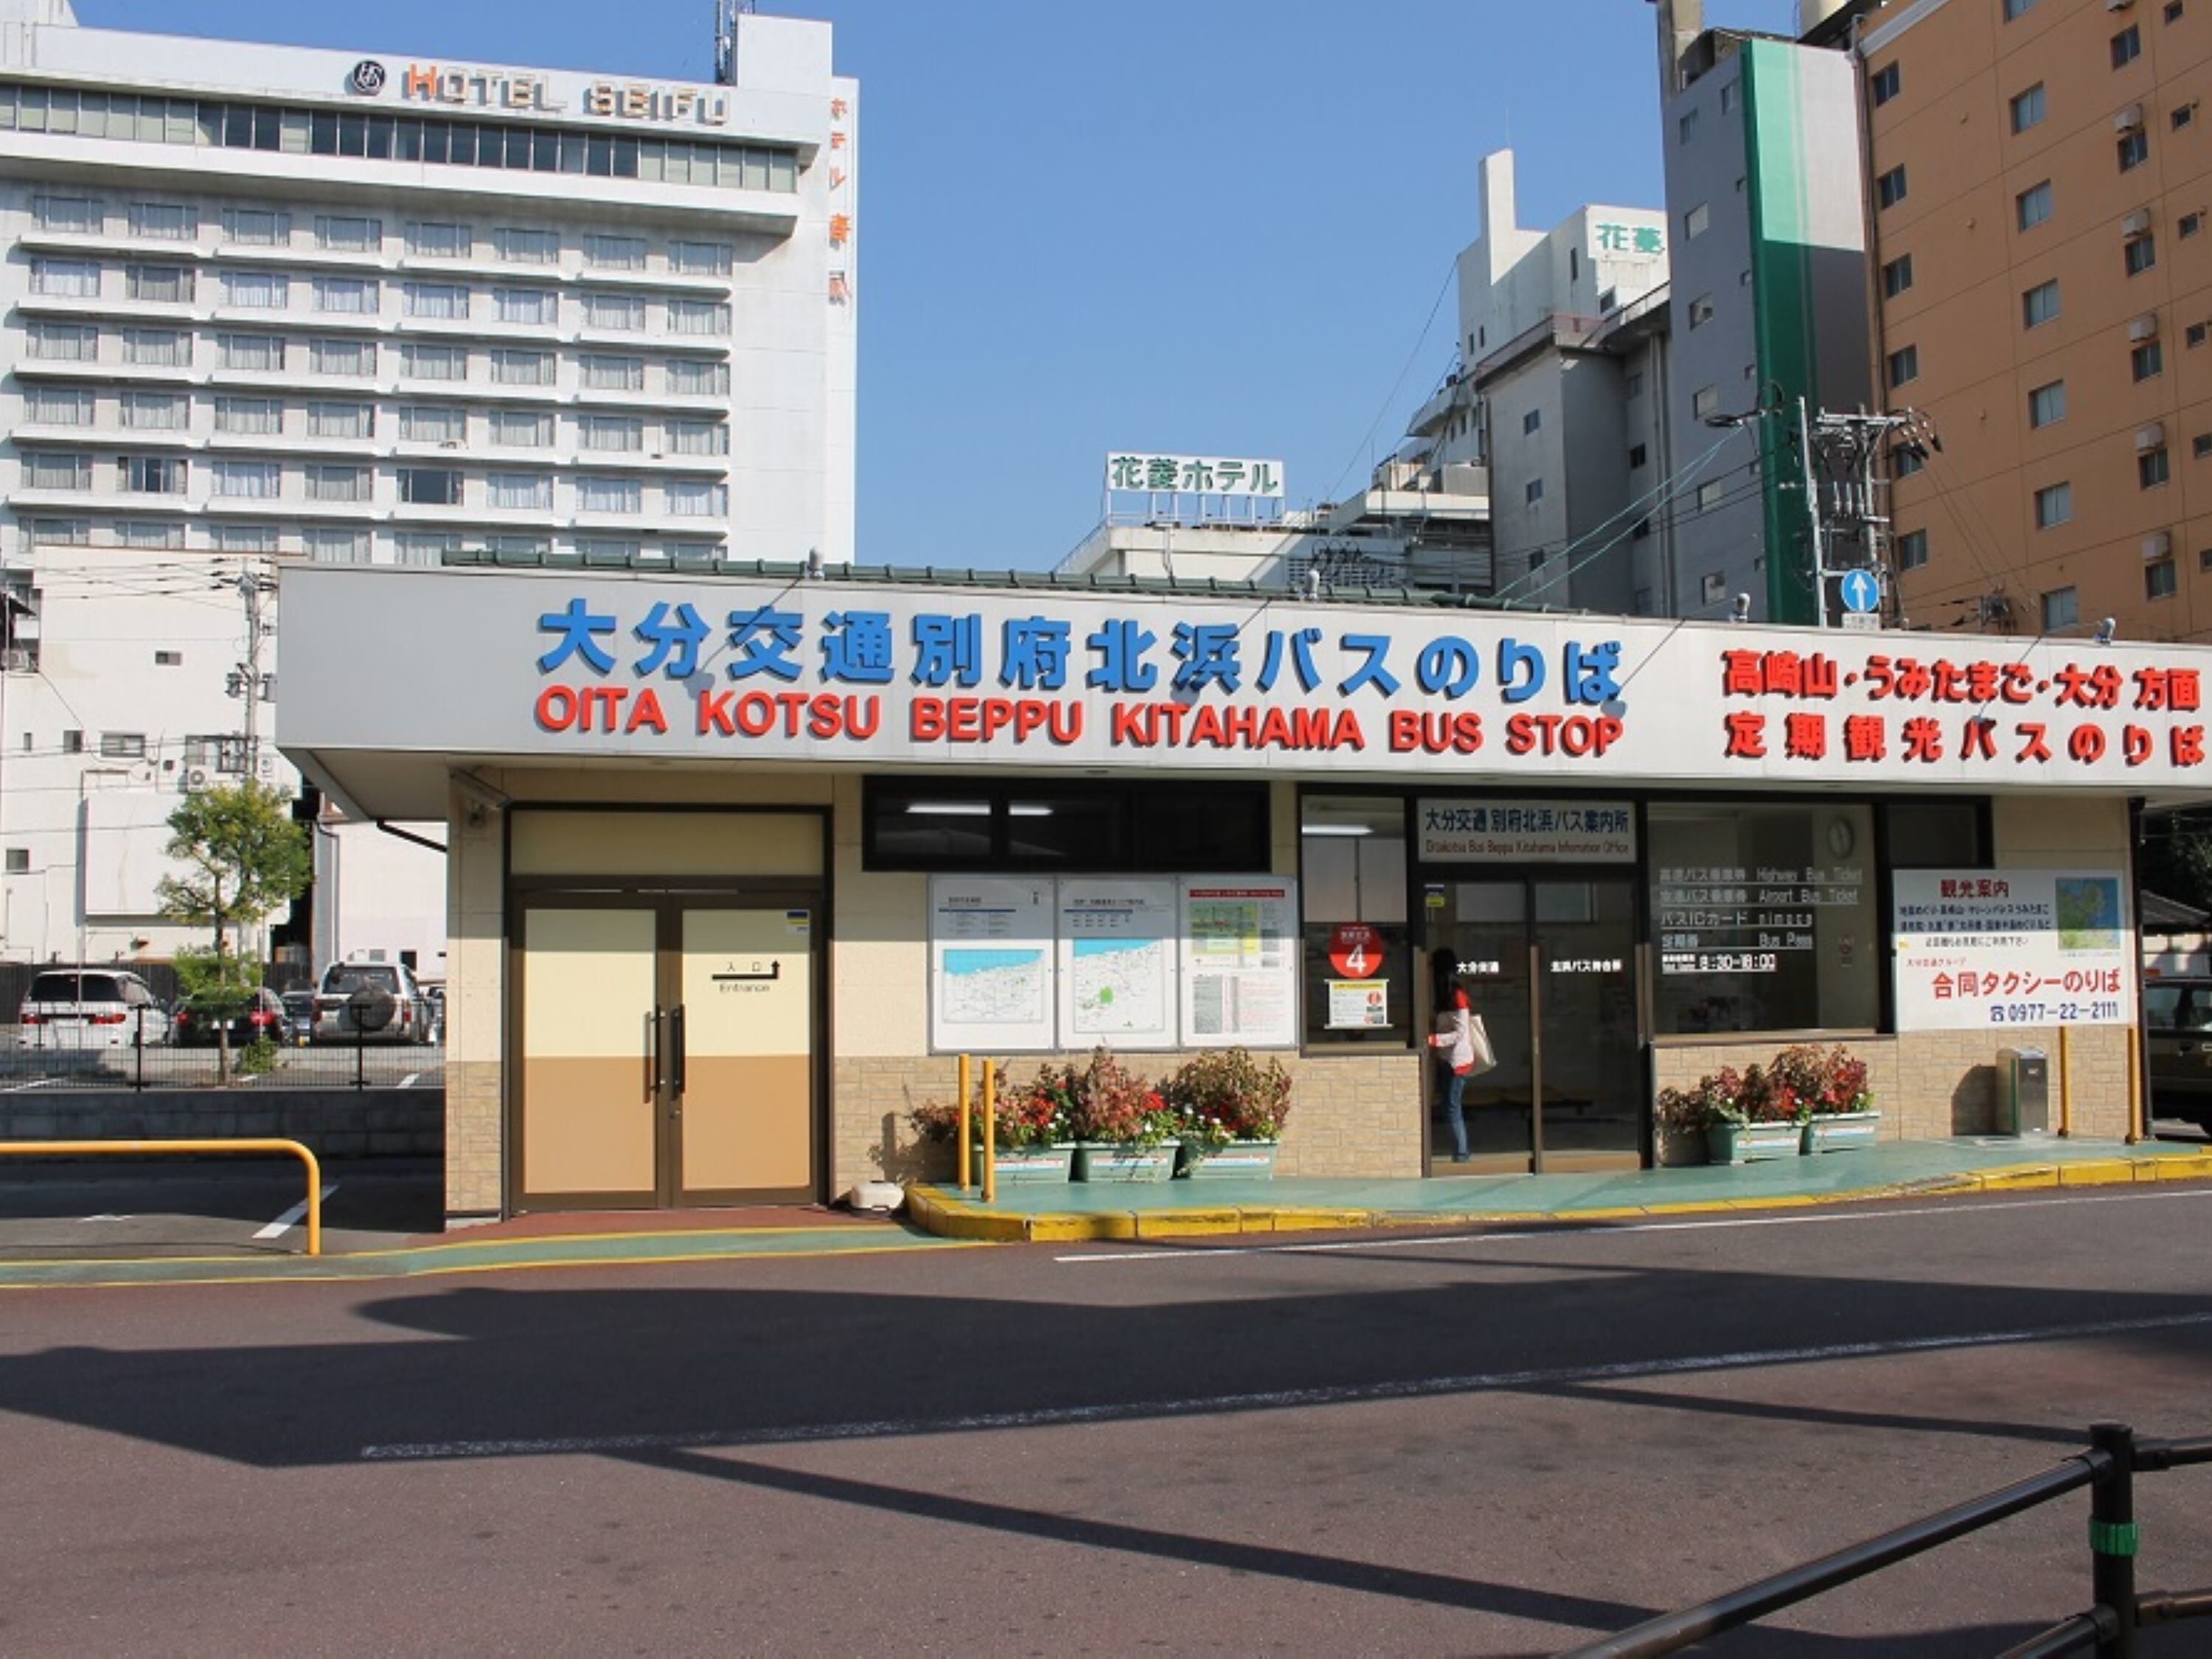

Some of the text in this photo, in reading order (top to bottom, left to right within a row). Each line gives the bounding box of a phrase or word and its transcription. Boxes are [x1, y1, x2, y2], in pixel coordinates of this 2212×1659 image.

[408, 62, 731, 125] HOTEL SEIFU
[1110, 455, 1279, 494] 花菱ホテル
[538, 597, 1622, 703] 大分交通別府北浜バスのりば
[536, 685, 1624, 757] OITA KOTSU BEPPU KITAHAMA BUS STOP
[1724, 711, 2205, 768] 定期観光バスのりば
[1346, 943, 1368, 973] 4
[719, 983, 771, 993] Entrance
[1931, 967, 2121, 1000] 合同タクシーのりば
[2008, 1001, 2119, 1022] 0977-22-2111
